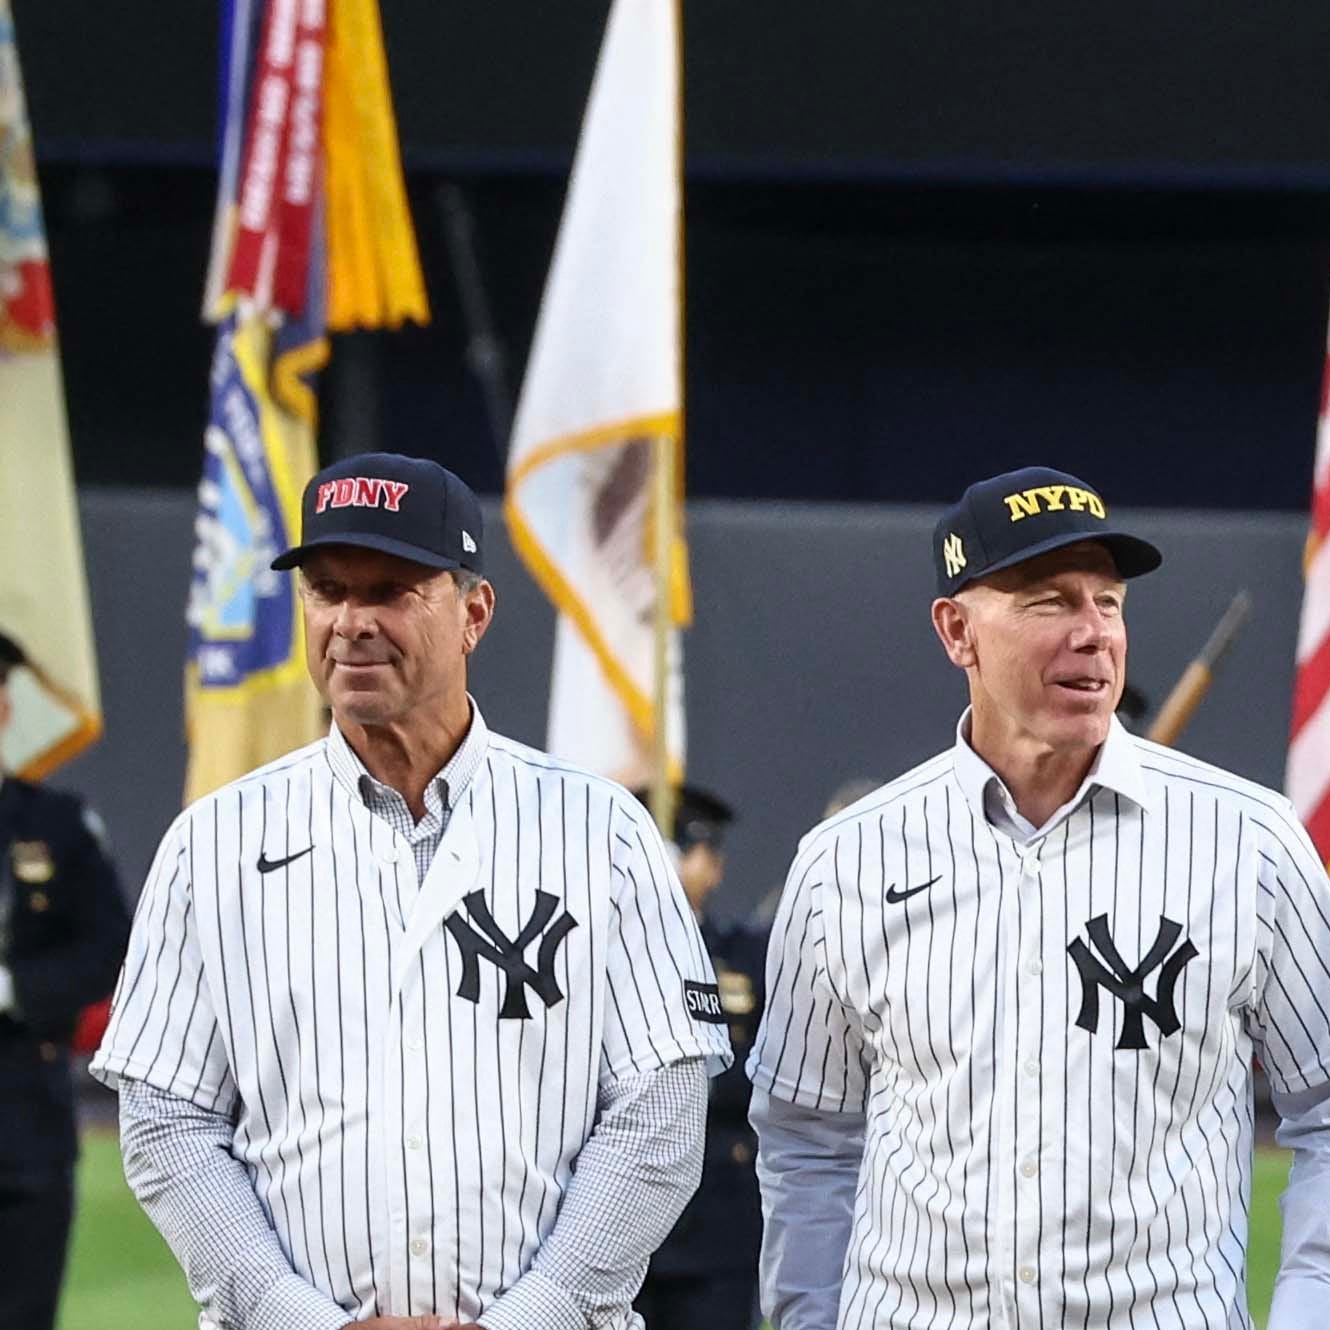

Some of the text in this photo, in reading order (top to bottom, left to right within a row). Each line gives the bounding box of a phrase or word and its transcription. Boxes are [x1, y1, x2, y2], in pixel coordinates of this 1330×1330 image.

[315, 477, 408, 514] FDNY
[1004, 485, 1106, 522] NYPD
[943, 532, 968, 579] NY
[444, 887, 579, 1020] NY
[1066, 912, 1200, 1050] NY
